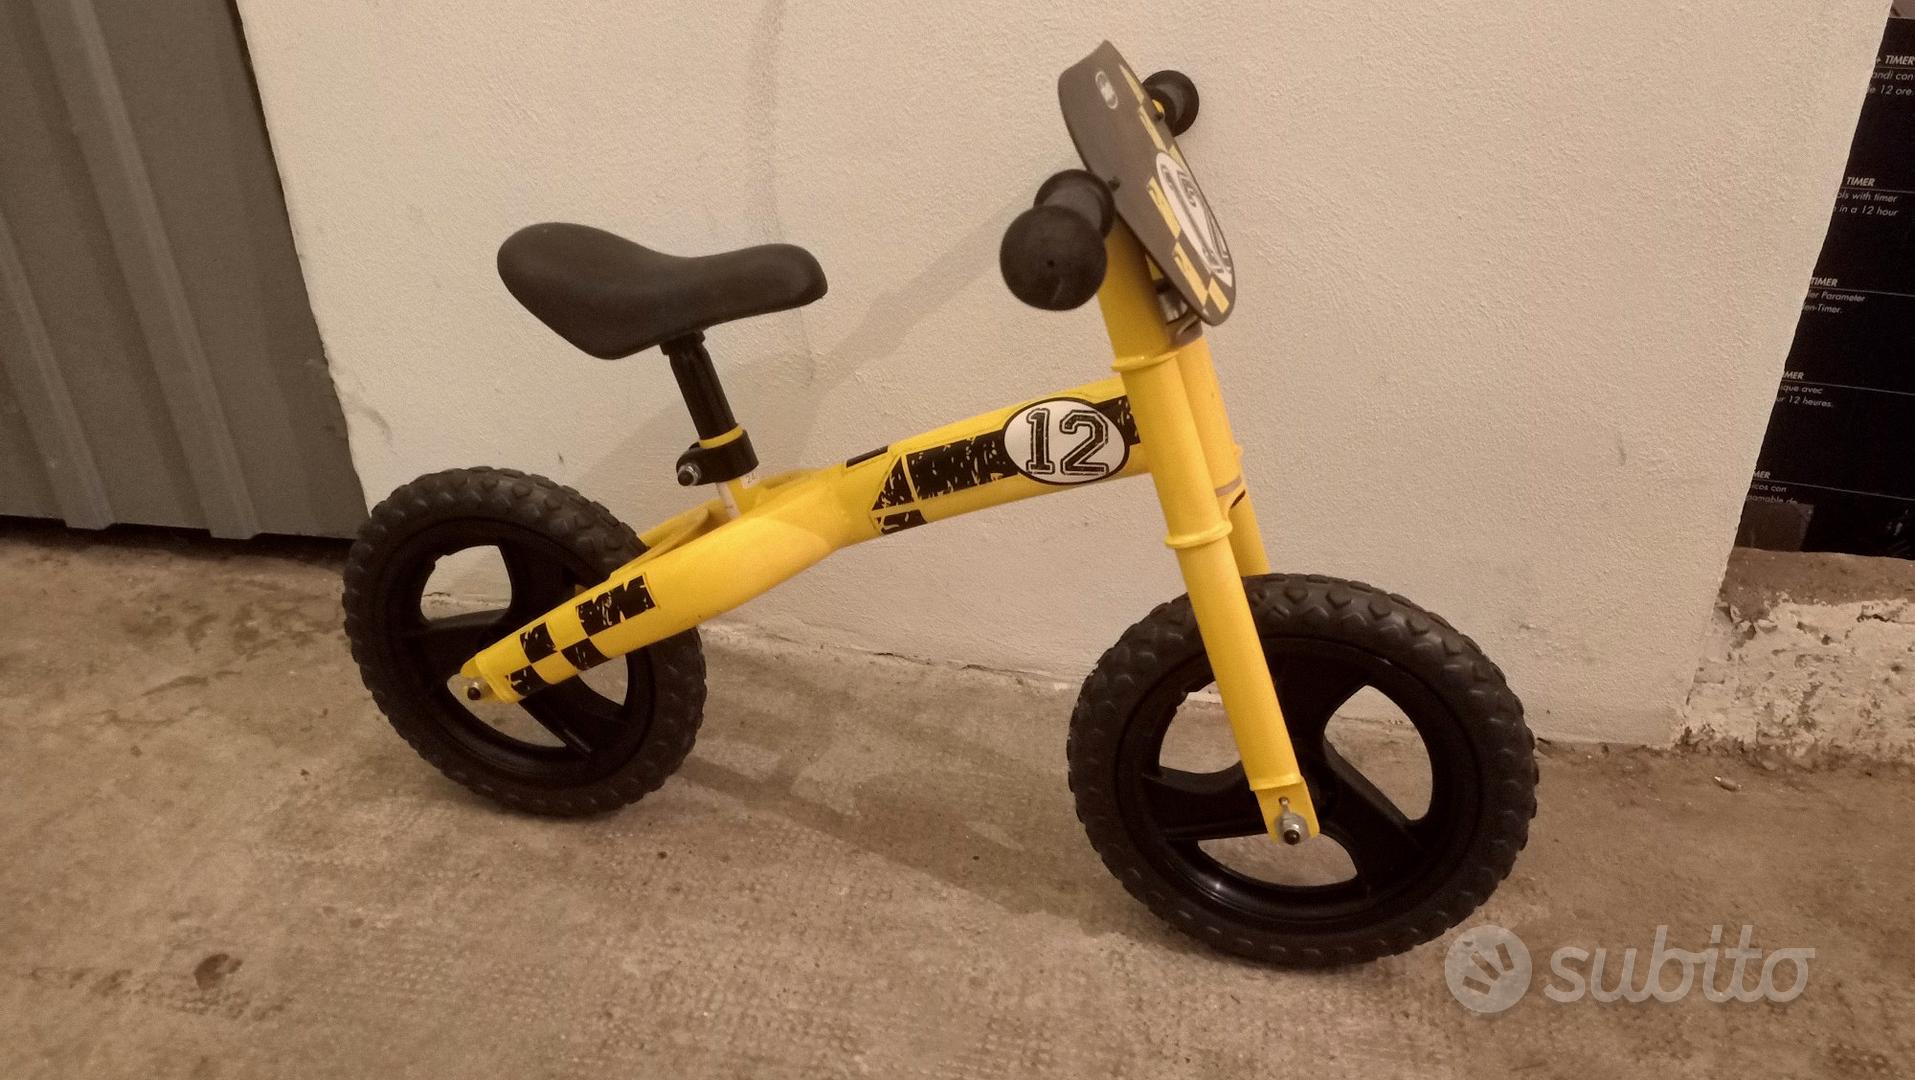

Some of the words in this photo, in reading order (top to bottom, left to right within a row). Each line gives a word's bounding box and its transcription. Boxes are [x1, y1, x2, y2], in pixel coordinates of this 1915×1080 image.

[1885, 55, 1915, 65] TIMER
[1880, 84, 1894, 95] 12
[1846, 176, 1876, 187] TIMER
[1852, 191, 1871, 201] with
[1873, 193, 1898, 203] timer
[1839, 204, 1848, 213] in
[1861, 205, 1875, 215] 12
[1876, 206, 1898, 217] hour
[1810, 276, 1838, 287] TIMER
[1821, 291, 1866, 302] Parameter
[1801, 386, 1823, 395] avec
[1789, 395, 1801, 405] 12
[1025, 407, 1110, 476] 12
[1770, 484, 1787, 493] con
